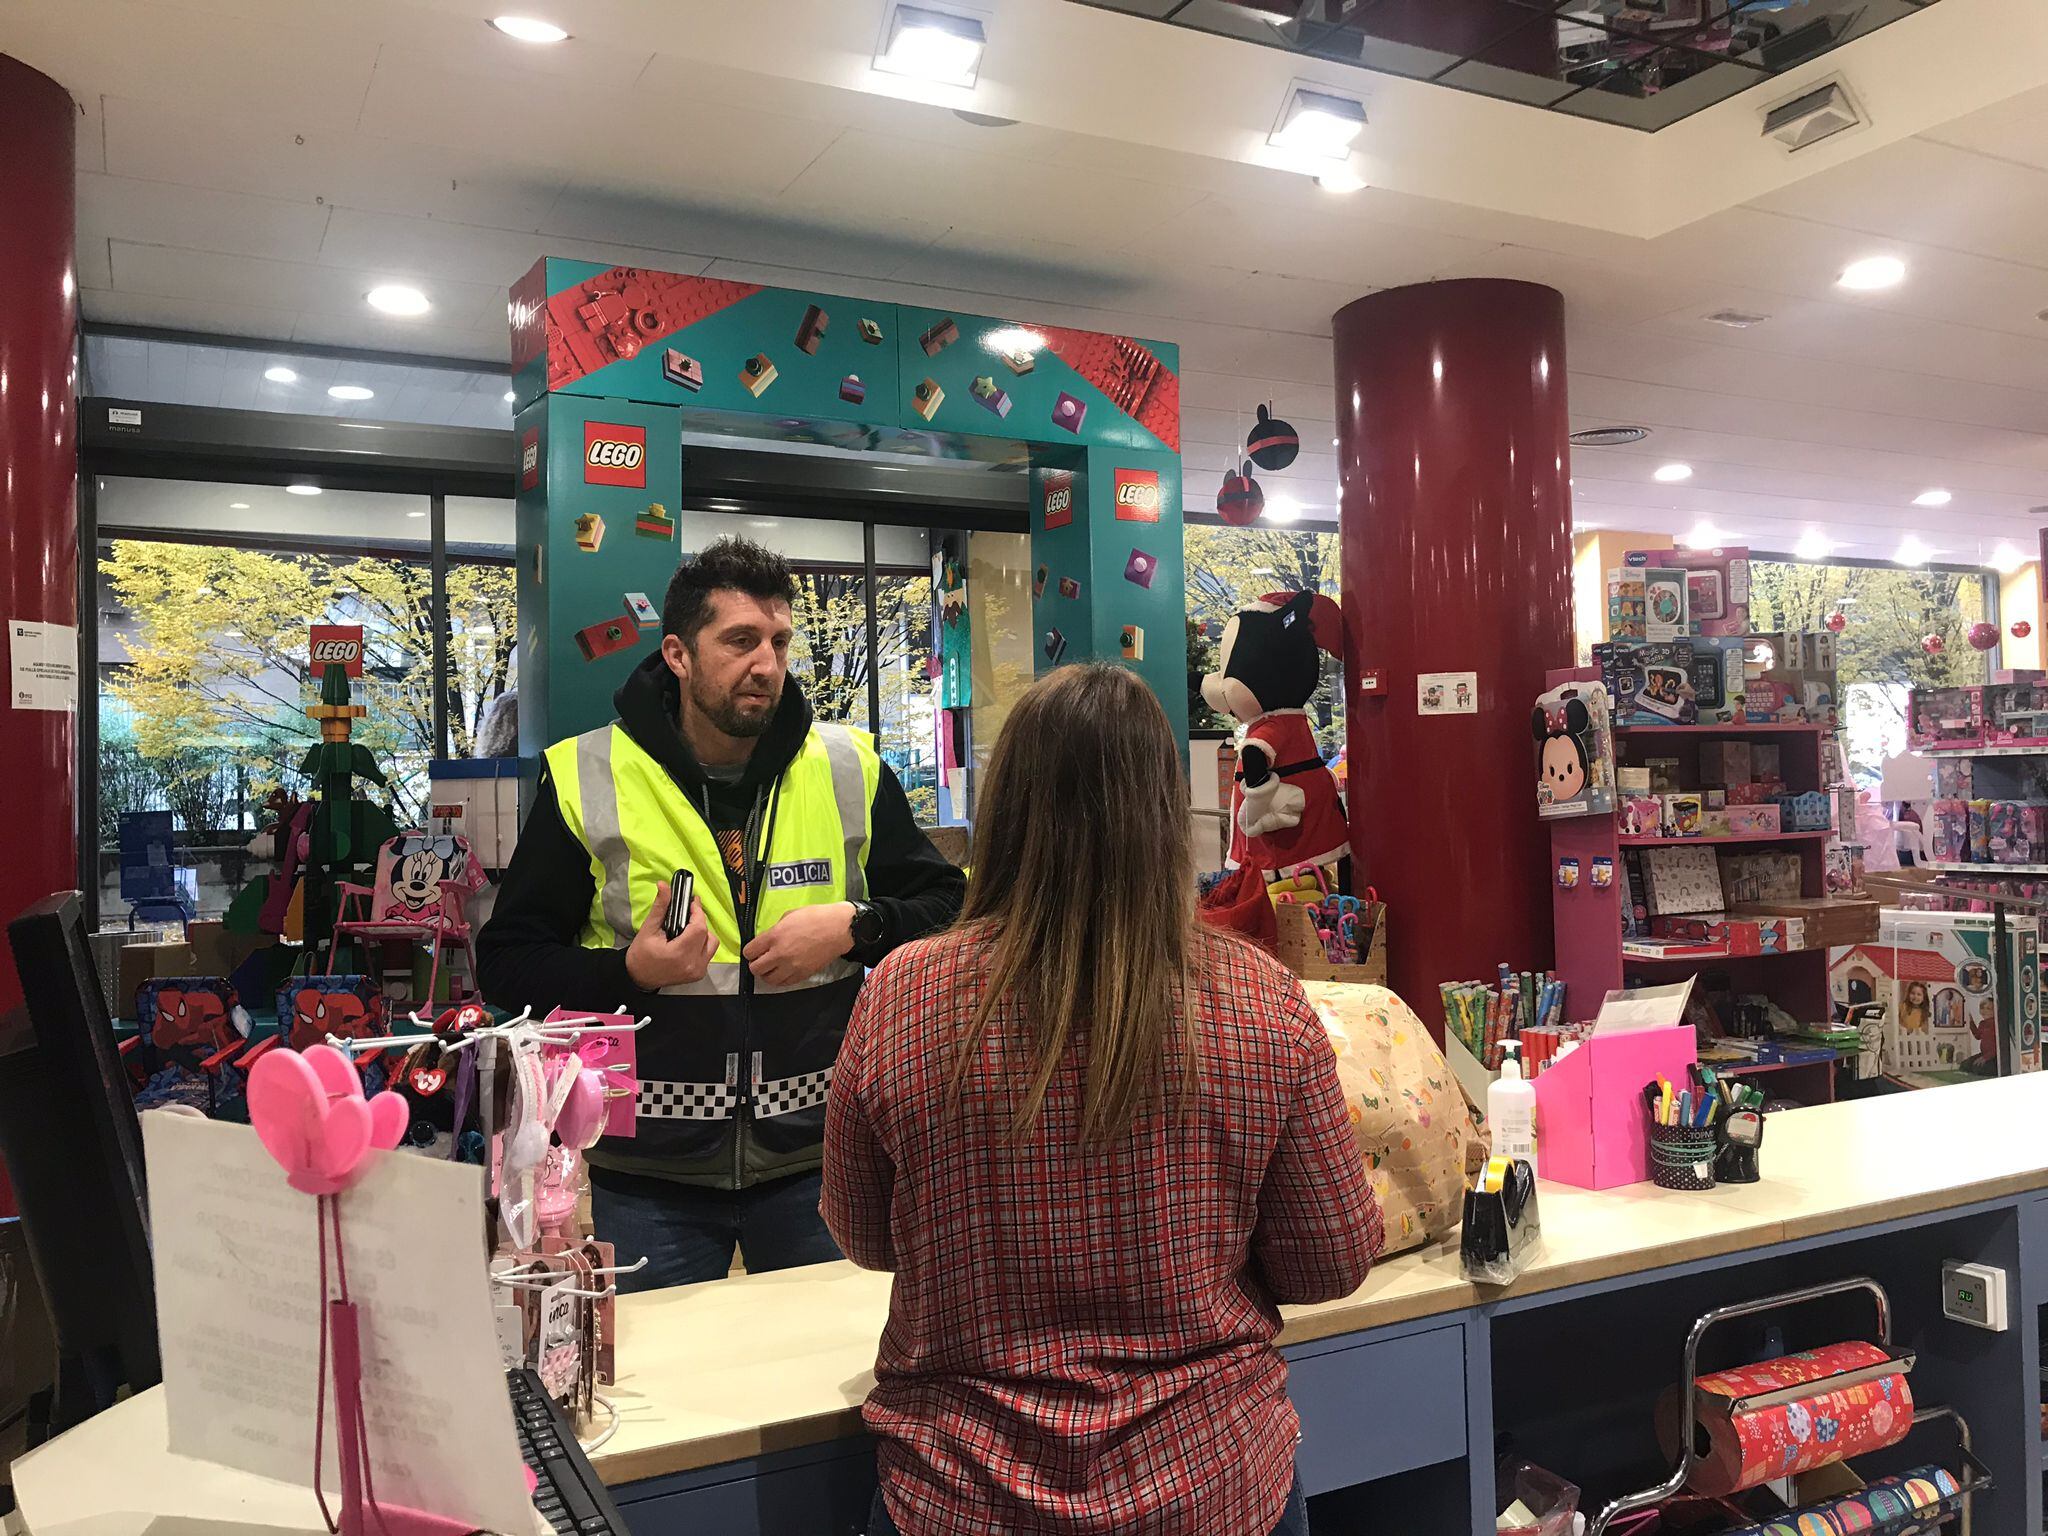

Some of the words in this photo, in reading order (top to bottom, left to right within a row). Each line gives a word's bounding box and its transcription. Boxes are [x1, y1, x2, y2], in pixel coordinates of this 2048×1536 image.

[109, 425, 141, 433] manusa
[523, 443, 537, 471] LEGO
[588, 440, 643, 468] LEGO
[1046, 488, 1070, 514] LEGO
[1118, 483, 1157, 507] LEGO
[314, 640, 359, 662] LEGO
[771, 864, 829, 885] POLICIA
[415, 1072, 441, 1091] ty
[548, 1301, 570, 1324] inca
